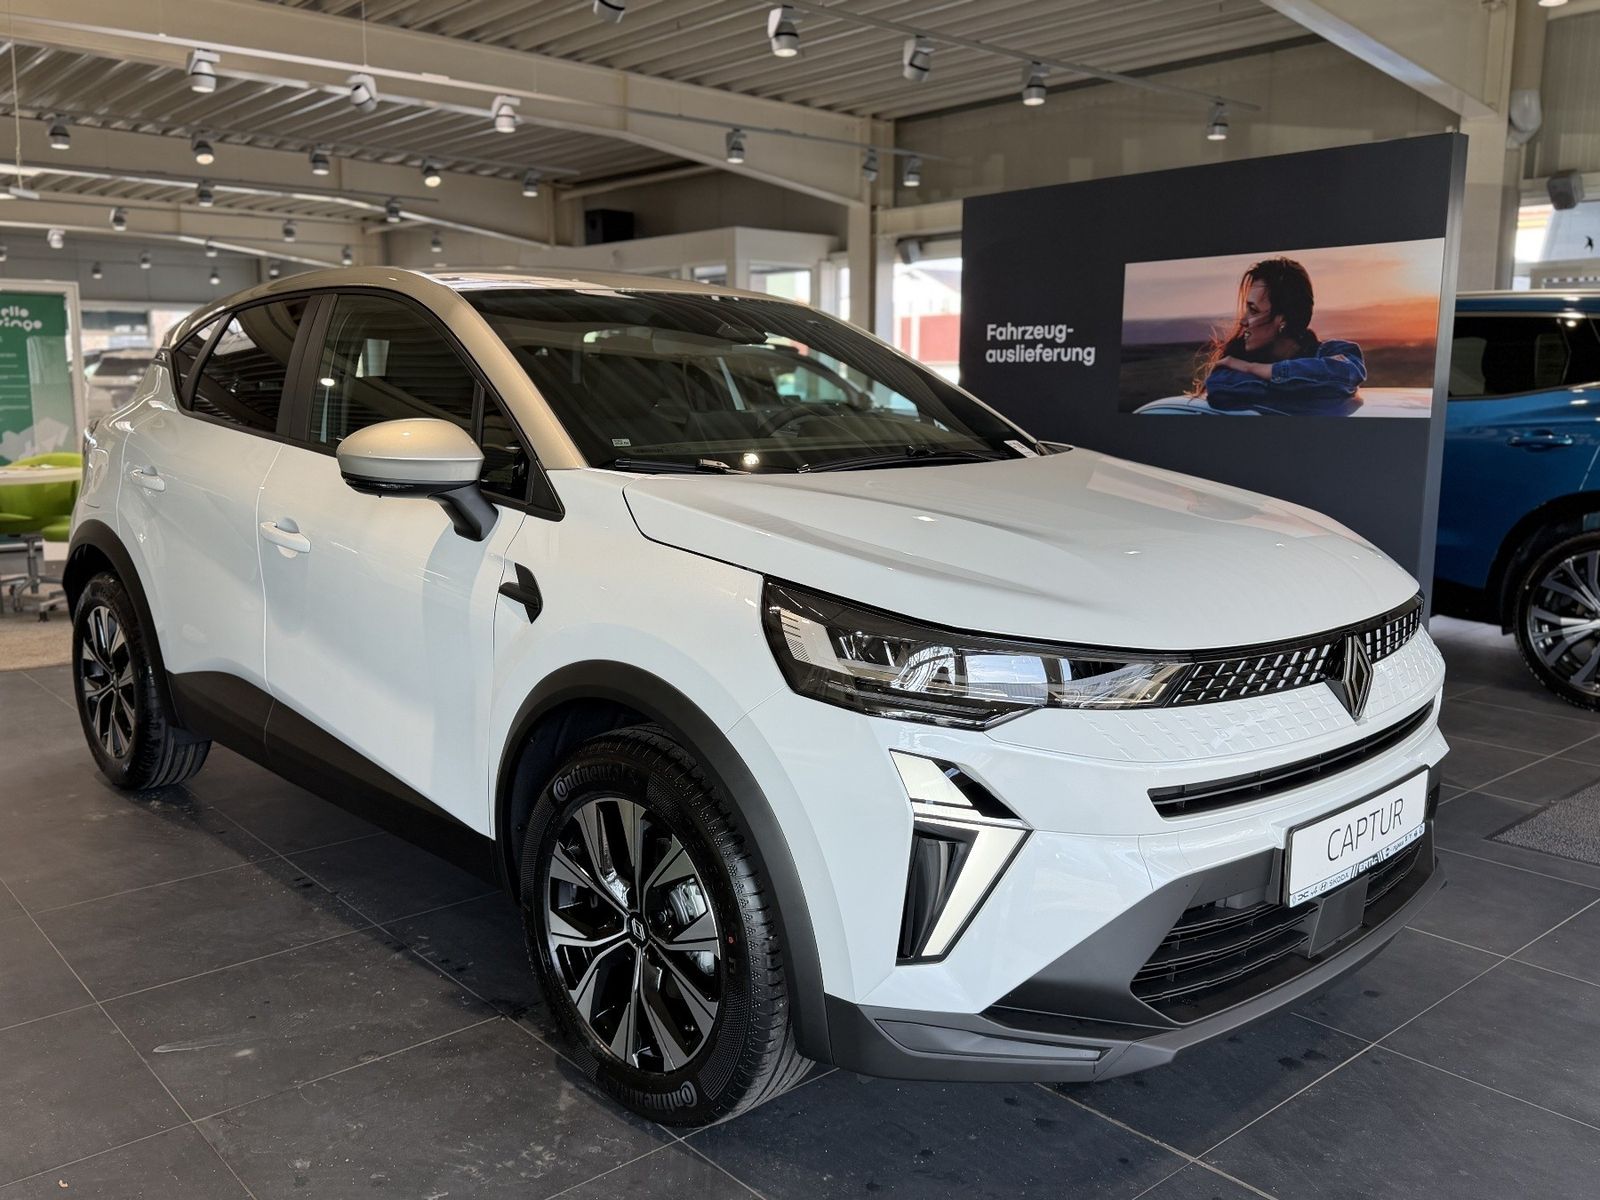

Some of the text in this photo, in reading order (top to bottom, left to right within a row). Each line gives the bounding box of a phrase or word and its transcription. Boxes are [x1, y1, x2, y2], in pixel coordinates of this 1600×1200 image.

[986, 322, 1074, 343] Fahrzeug-
[985, 344, 1096, 366] auslieferung
[1327, 798, 1404, 861] CAPTUR
[616, 1080, 698, 1111] Continen
